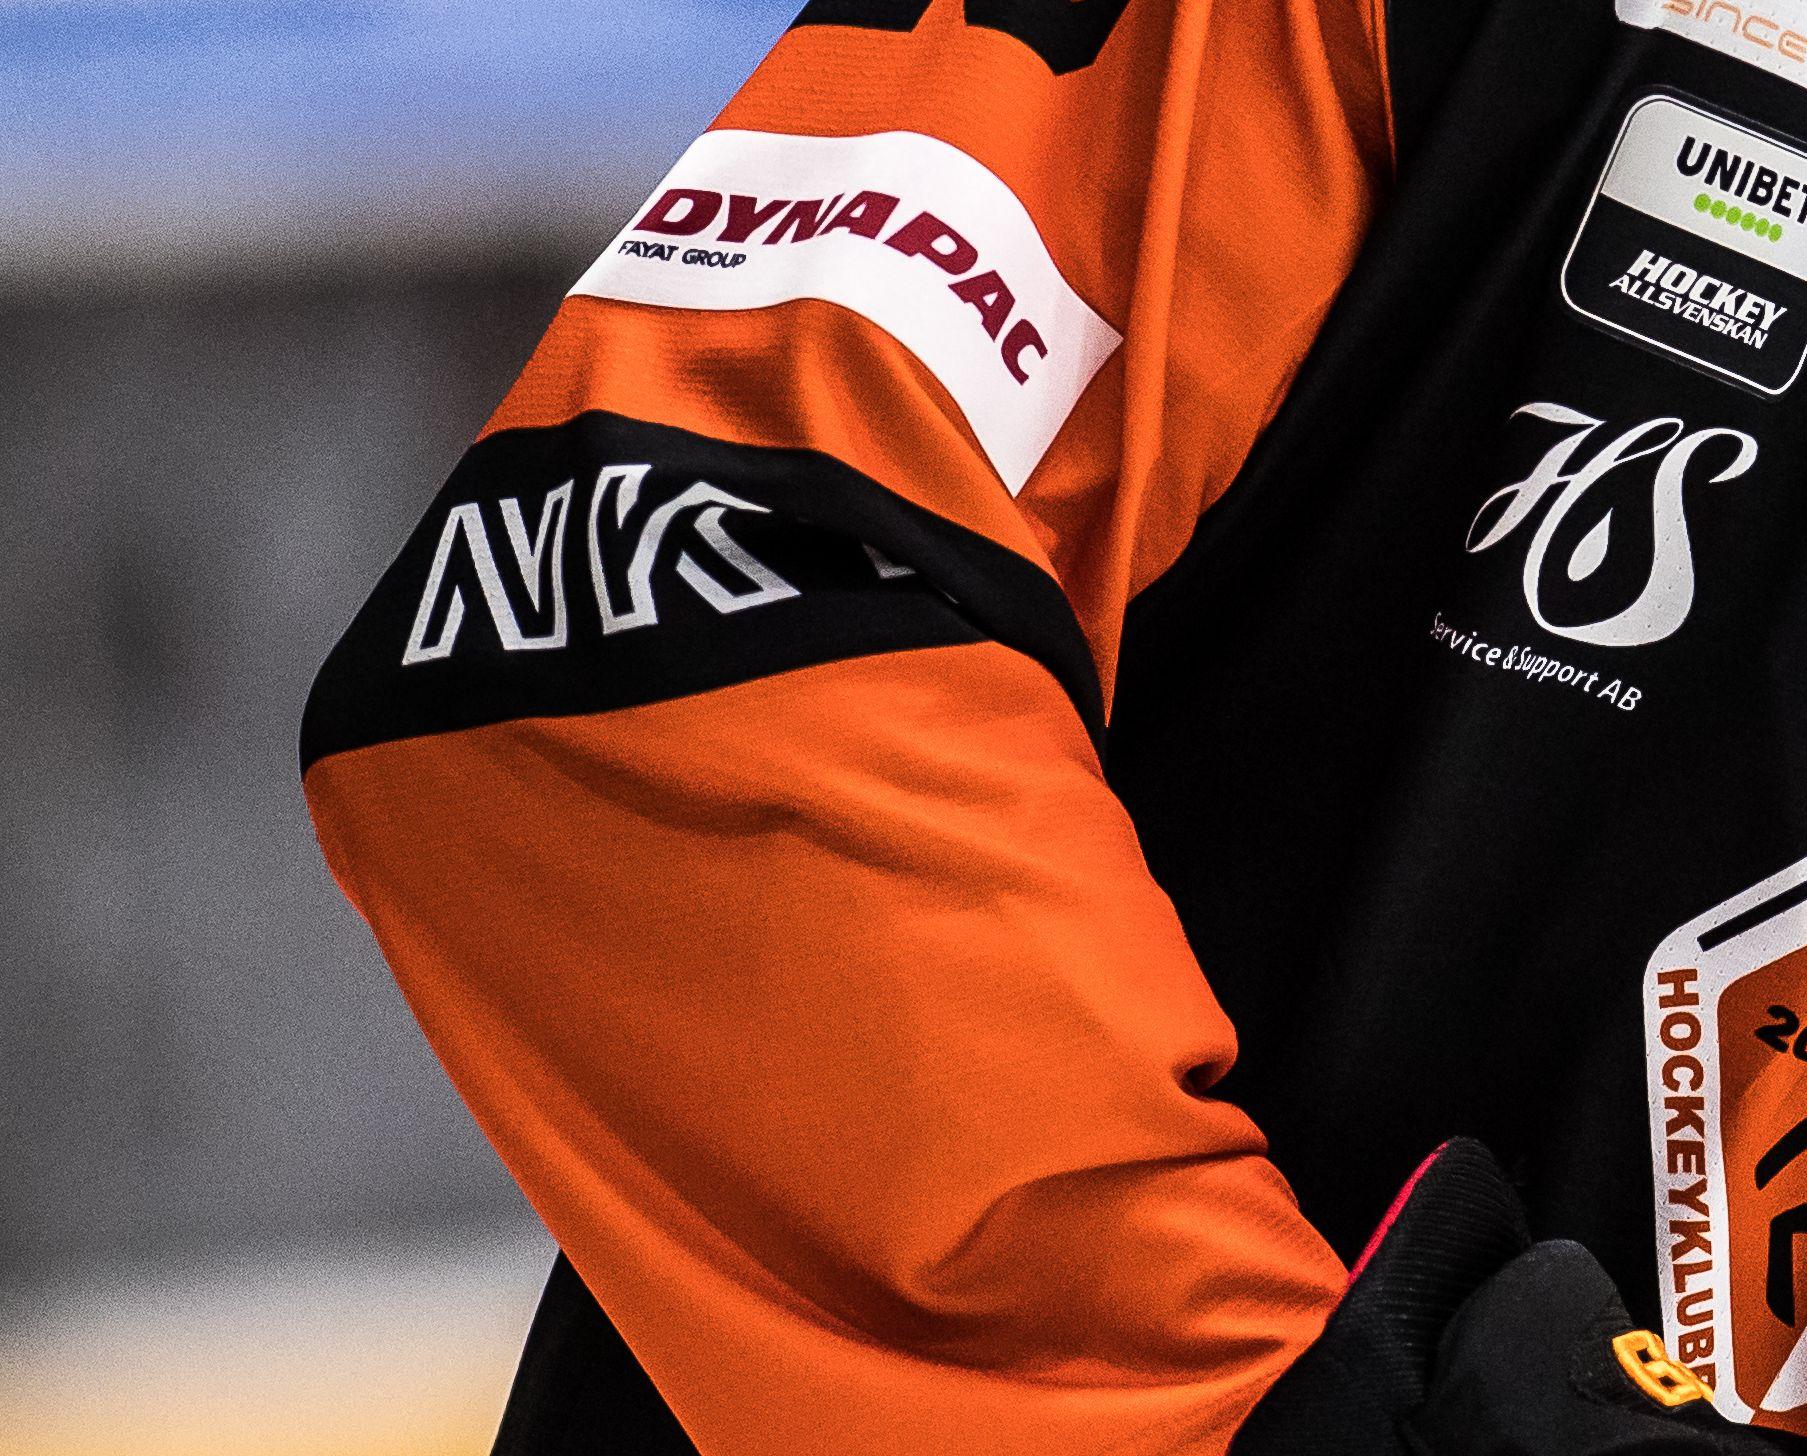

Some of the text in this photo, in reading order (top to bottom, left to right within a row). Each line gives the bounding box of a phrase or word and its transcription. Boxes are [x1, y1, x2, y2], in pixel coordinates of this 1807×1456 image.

[617, 240, 747, 269] FAYAT GROUP
[633, 188, 1048, 386] DYNAPAC
[1626, 249, 1788, 331] HOCKEY
[1609, 274, 1768, 349] ALLSVENSKAN
[400, 463, 916, 666] NK
[1430, 611, 1502, 666] Service
[1597, 679, 1643, 711] AB
